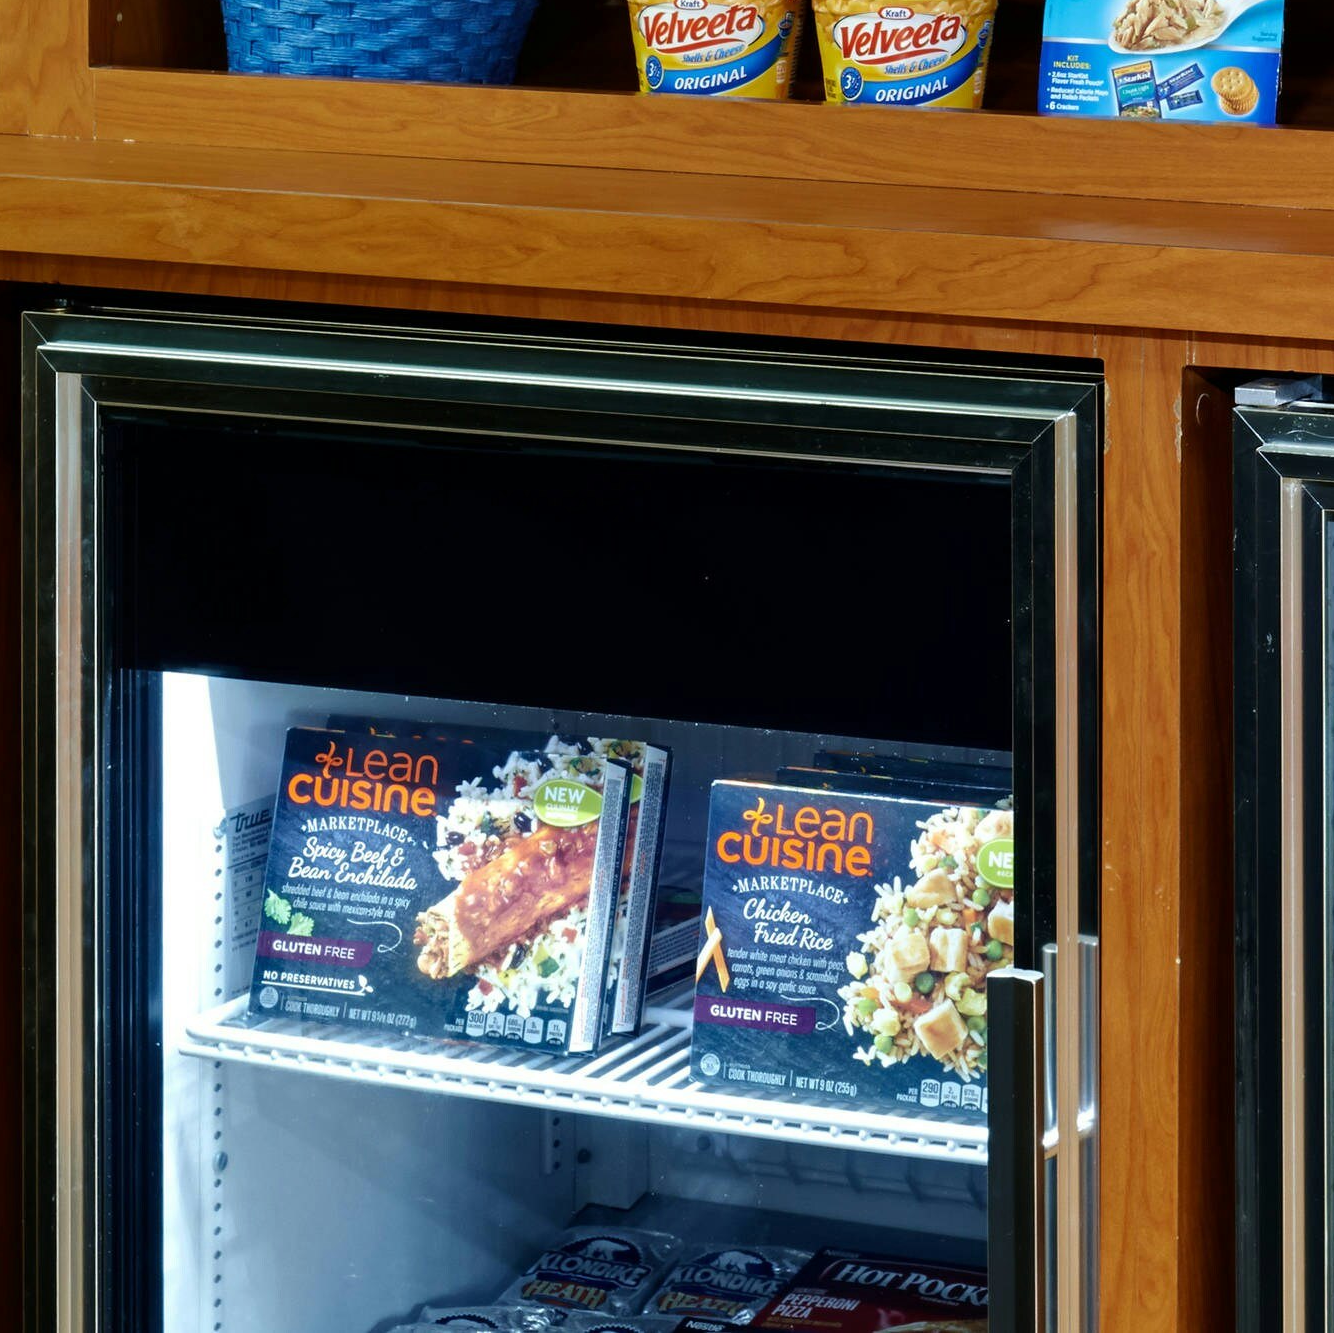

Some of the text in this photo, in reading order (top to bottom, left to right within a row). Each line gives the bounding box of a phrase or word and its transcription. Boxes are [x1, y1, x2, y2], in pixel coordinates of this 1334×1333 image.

[644, 4, 758, 47] Velveeta
[840, 14, 961, 59] Velveeta
[674, 66, 747, 91] ORIGINAL
[875, 76, 949, 103] ORIGINAL
[1123, 72, 1152, 84] StarKist
[346, 747, 438, 785] Lean
[544, 786, 586, 804] NEW
[306, 816, 408, 842] MARKETPLACE
[776, 804, 874, 844] Lean
[303, 836, 348, 864] Spicy
[351, 841, 392, 868] Beef
[391, 848, 405, 866] &
[288, 857, 418, 890] Bean Enchilada
[737, 876, 844, 904] MARKETPLACE
[743, 898, 812, 925] Chicken
[272, 939, 355, 960] GLUTEN FREE
[754, 921, 834, 951] Fried Rice
[263, 970, 355, 990] NO PRESERVATIVES
[468, 1012, 484, 1024] 300
[710, 1004, 799, 1026] GLUTEN FREE
[922, 1082, 939, 1094] 290
[526, 1252, 649, 1287] KLONDIKE
[522, 1279, 606, 1310] HEATH
[833, 1263, 988, 1308] HOT POCK
[770, 1304, 814, 1319] PIZZA
[781, 1293, 861, 1312] PEPPERONI
